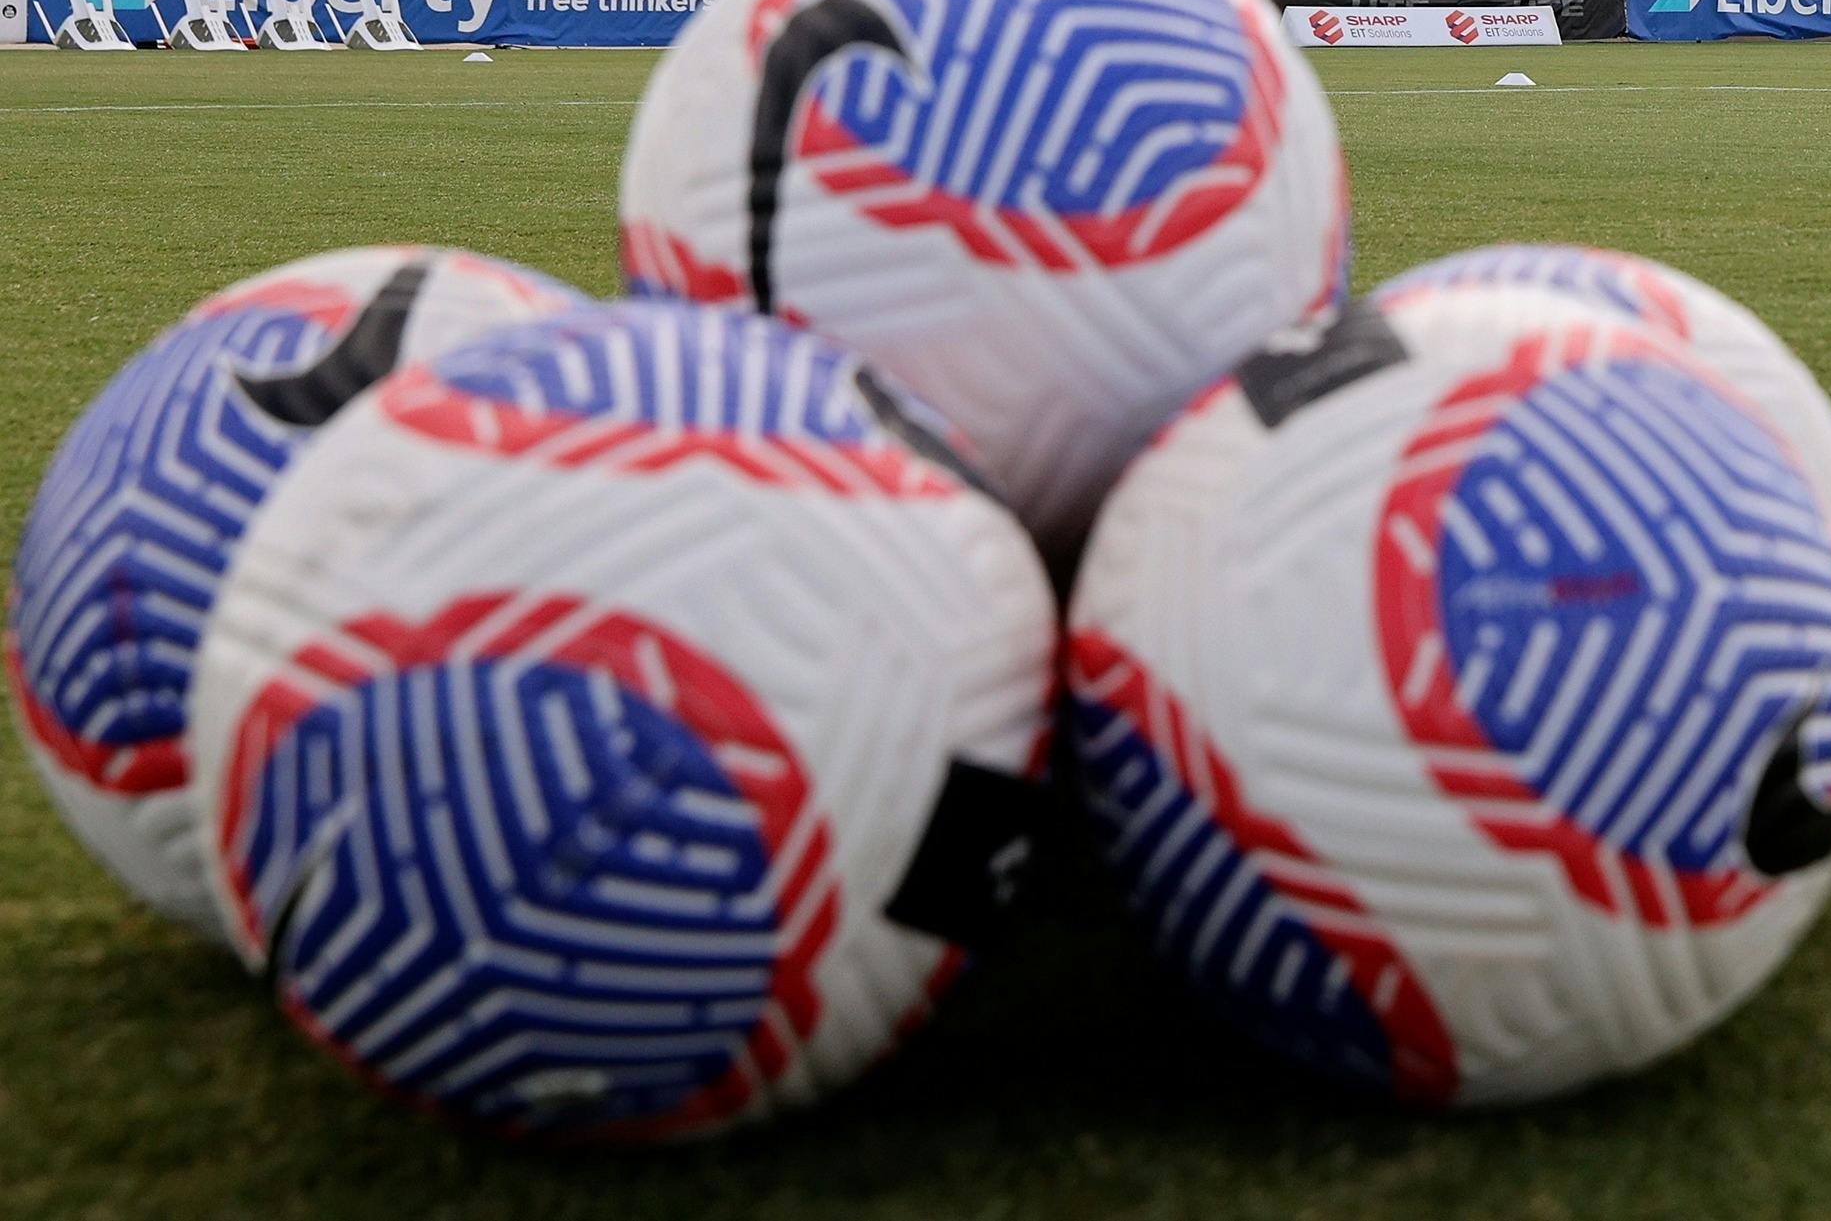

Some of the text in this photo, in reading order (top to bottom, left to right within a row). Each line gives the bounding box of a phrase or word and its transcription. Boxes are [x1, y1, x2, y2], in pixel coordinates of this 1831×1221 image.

[1346, 15, 1407, 27] SHARP
[1481, 14, 1539, 25] SHARP
[1350, 29, 1412, 39] EIT Solutions
[1485, 27, 1544, 37] EIT Solutions
